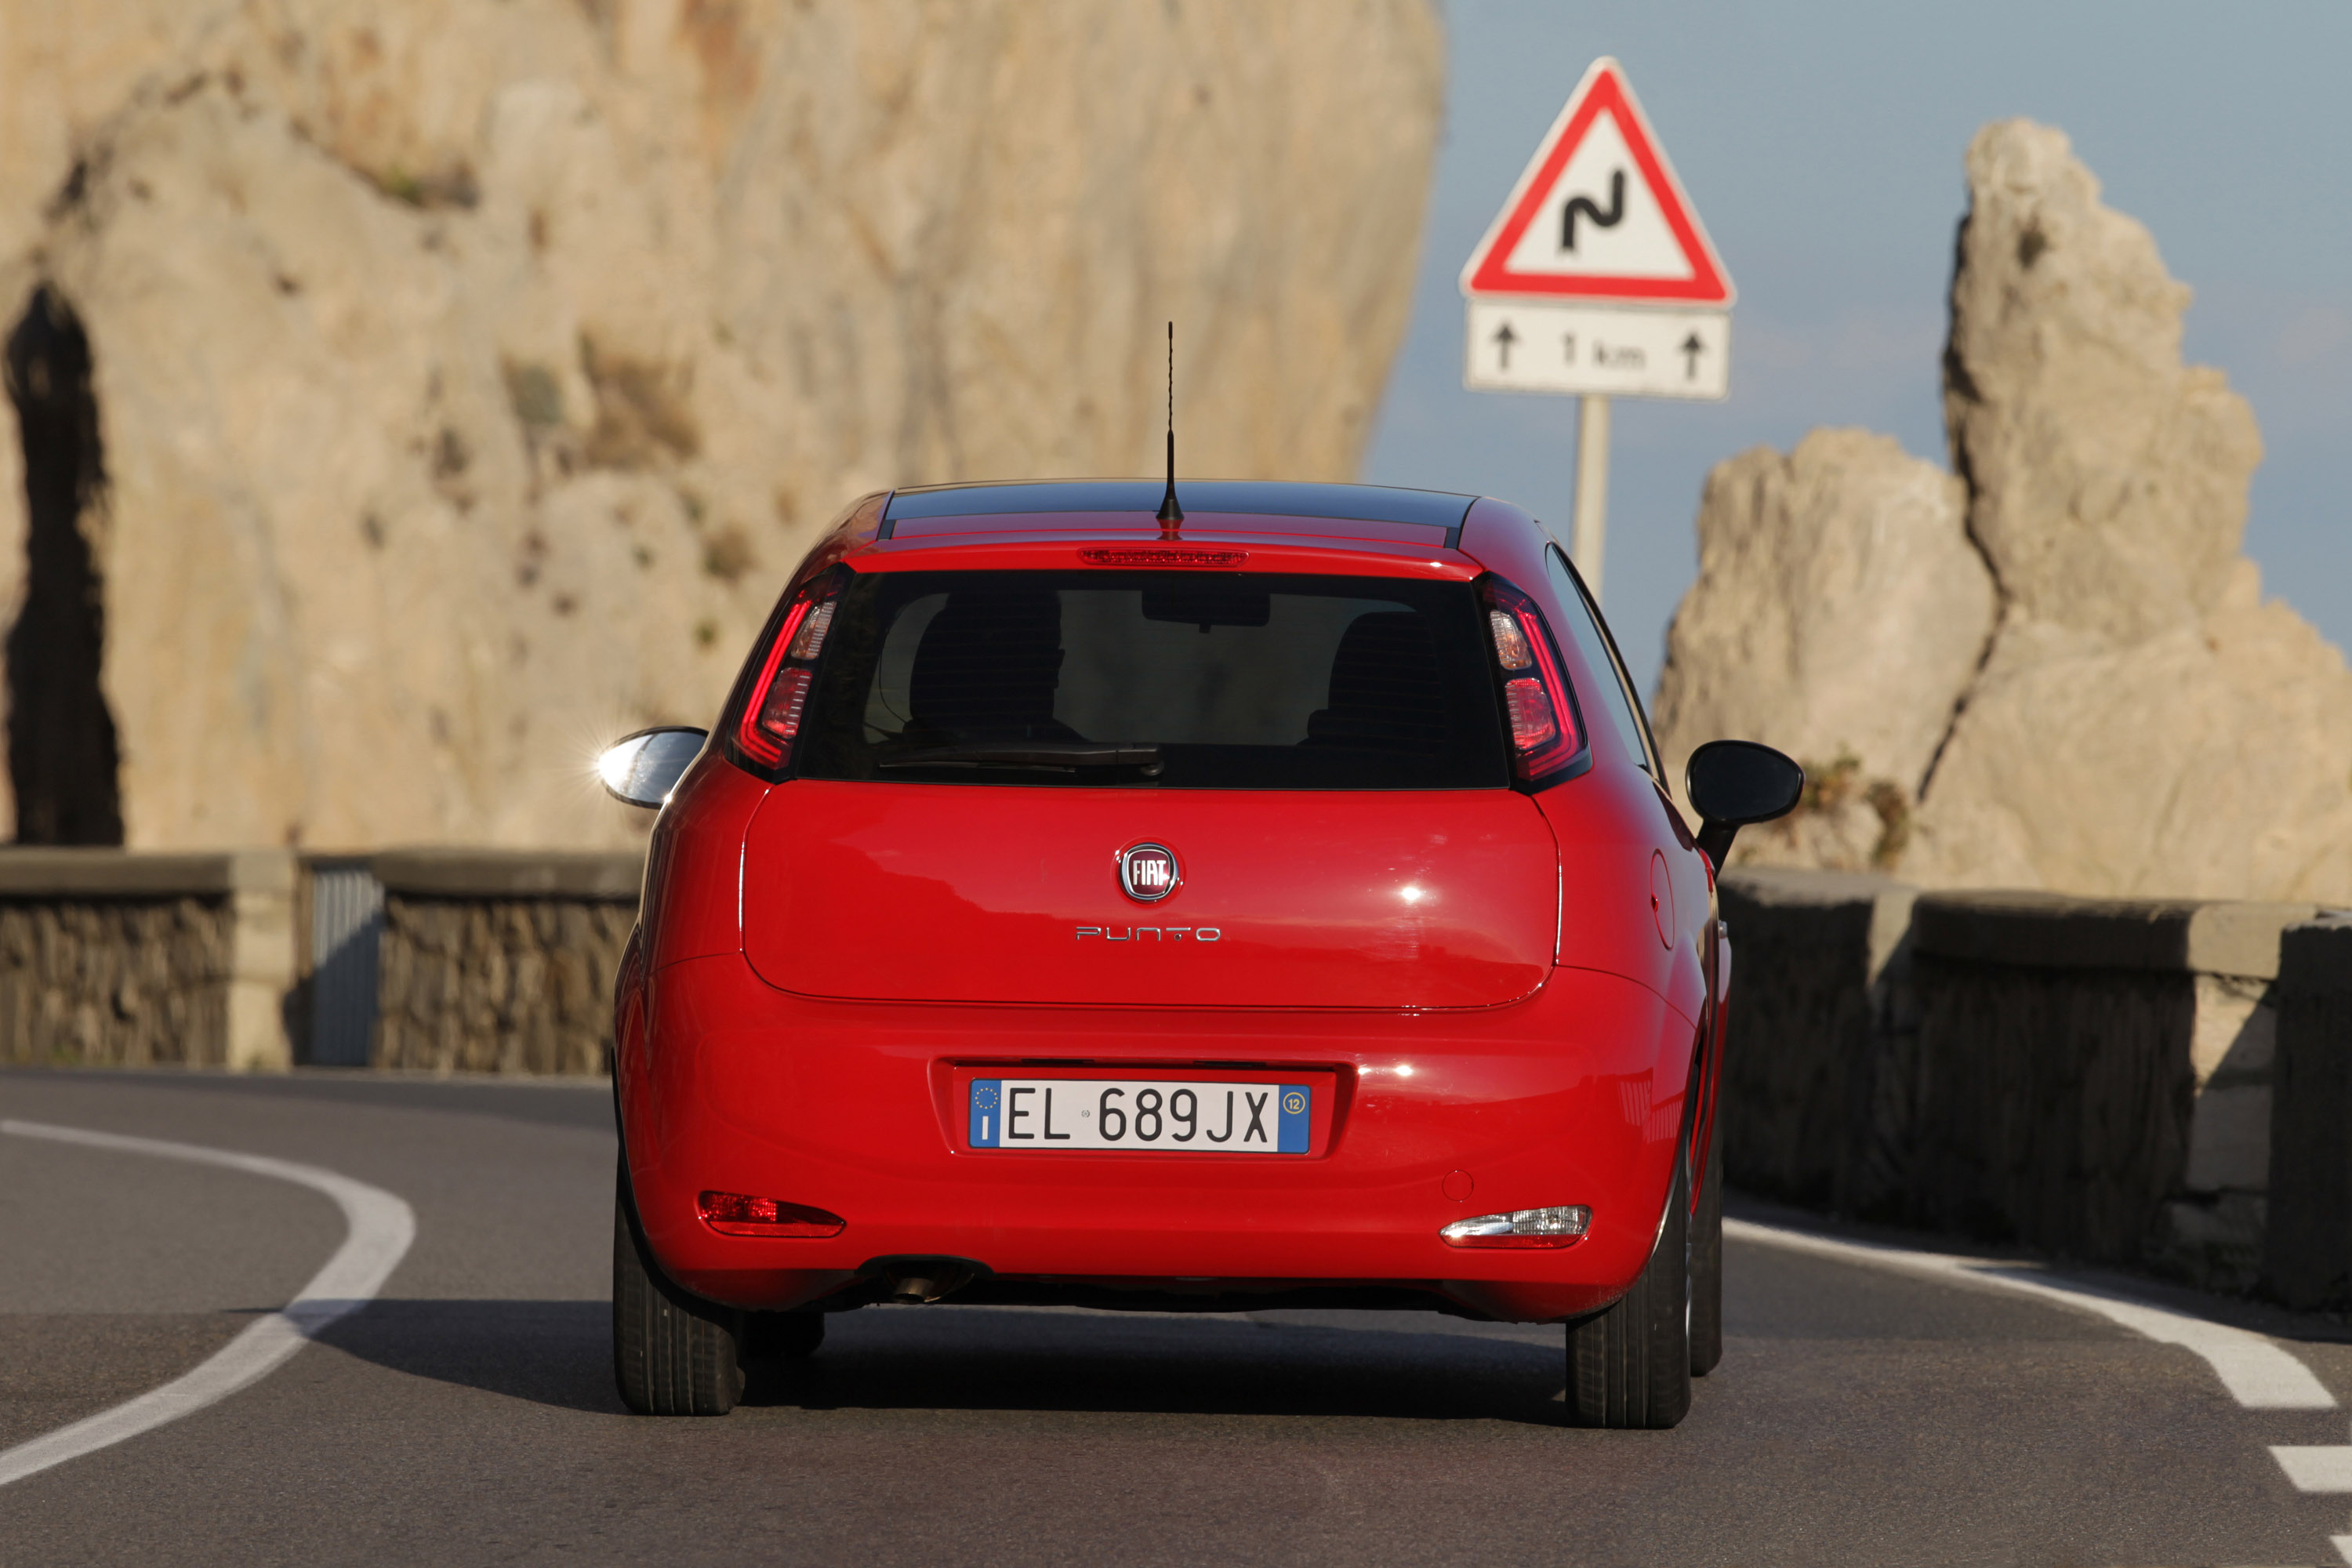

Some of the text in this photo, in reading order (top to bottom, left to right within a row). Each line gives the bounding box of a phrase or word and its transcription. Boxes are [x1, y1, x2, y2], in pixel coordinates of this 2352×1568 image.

[1562, 330, 1647, 368] 1 km
[1132, 860, 1167, 886] FIAT
[1076, 927, 1221, 941] PUNTO
[1008, 1087, 1269, 1143] EL 689JX
[1287, 1098, 1300, 1110] 12
[982, 1116, 989, 1140] I
